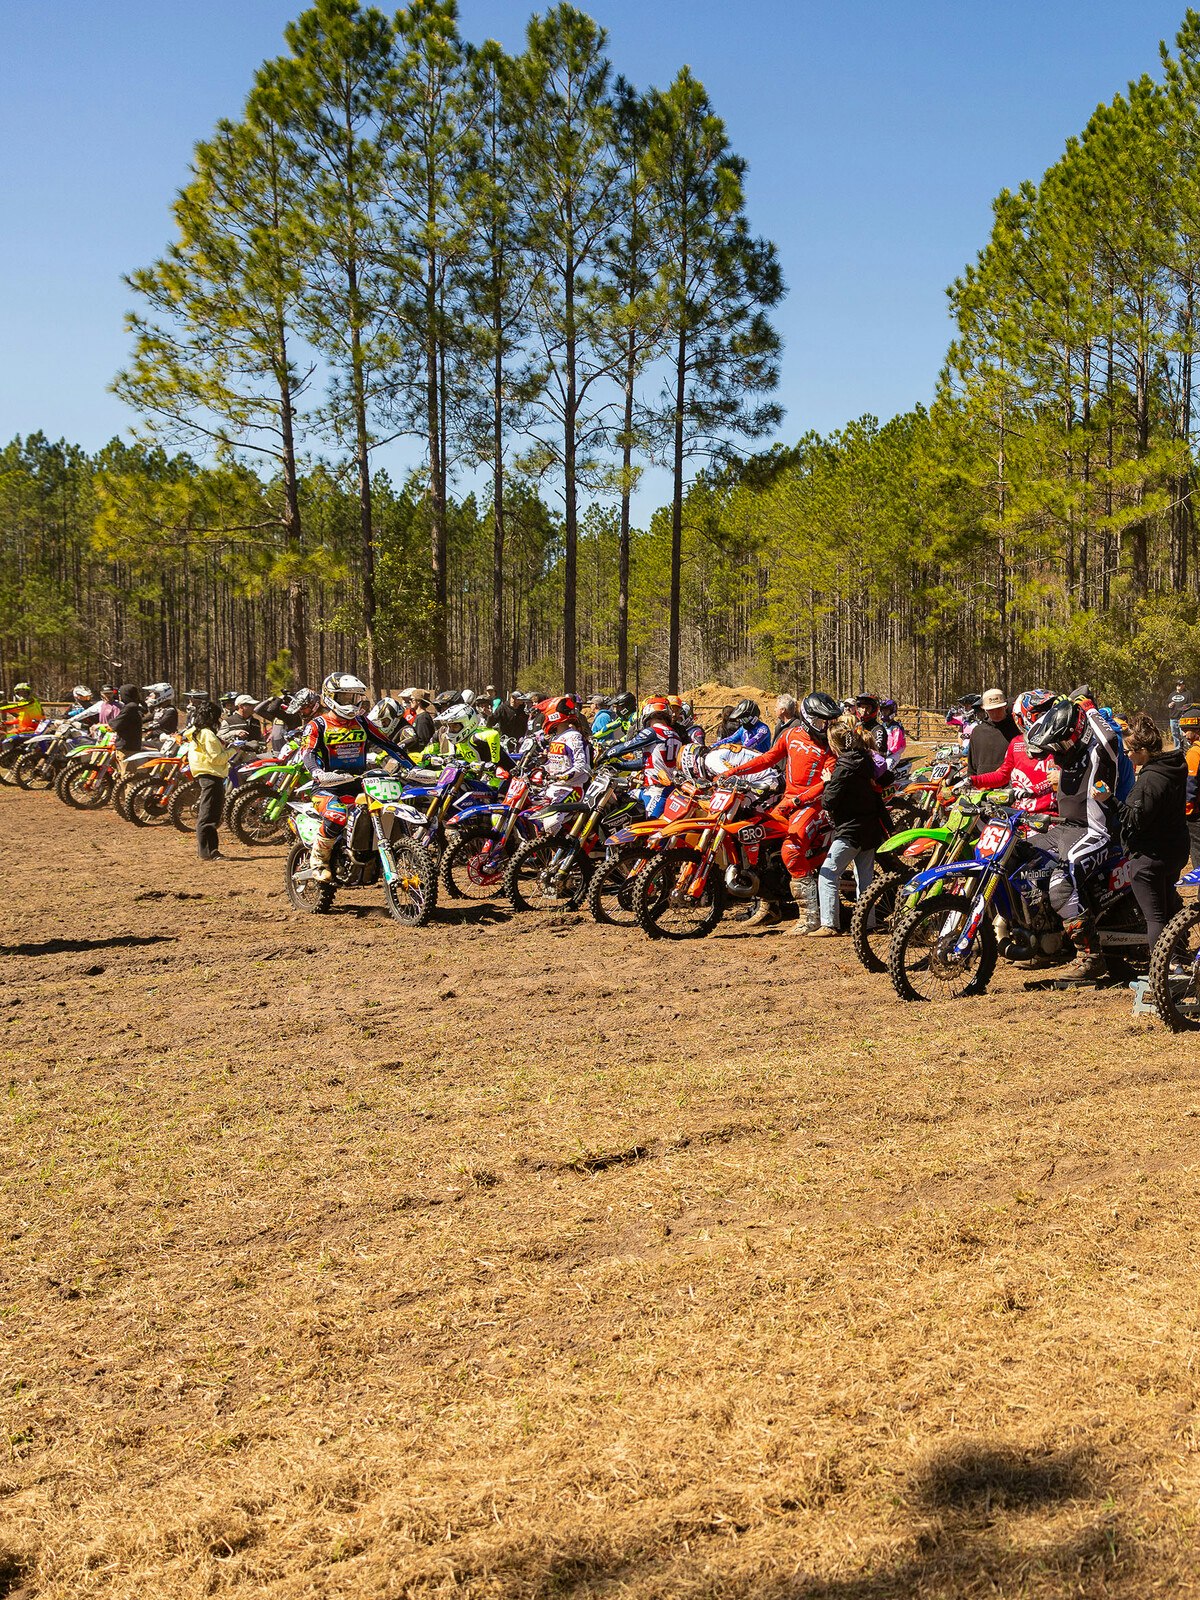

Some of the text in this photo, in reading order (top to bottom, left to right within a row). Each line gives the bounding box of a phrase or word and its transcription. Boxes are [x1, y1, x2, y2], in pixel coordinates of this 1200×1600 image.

[326, 731, 364, 745] FXR
[932, 767, 948, 778] 219
[741, 828, 763, 841] BRO
